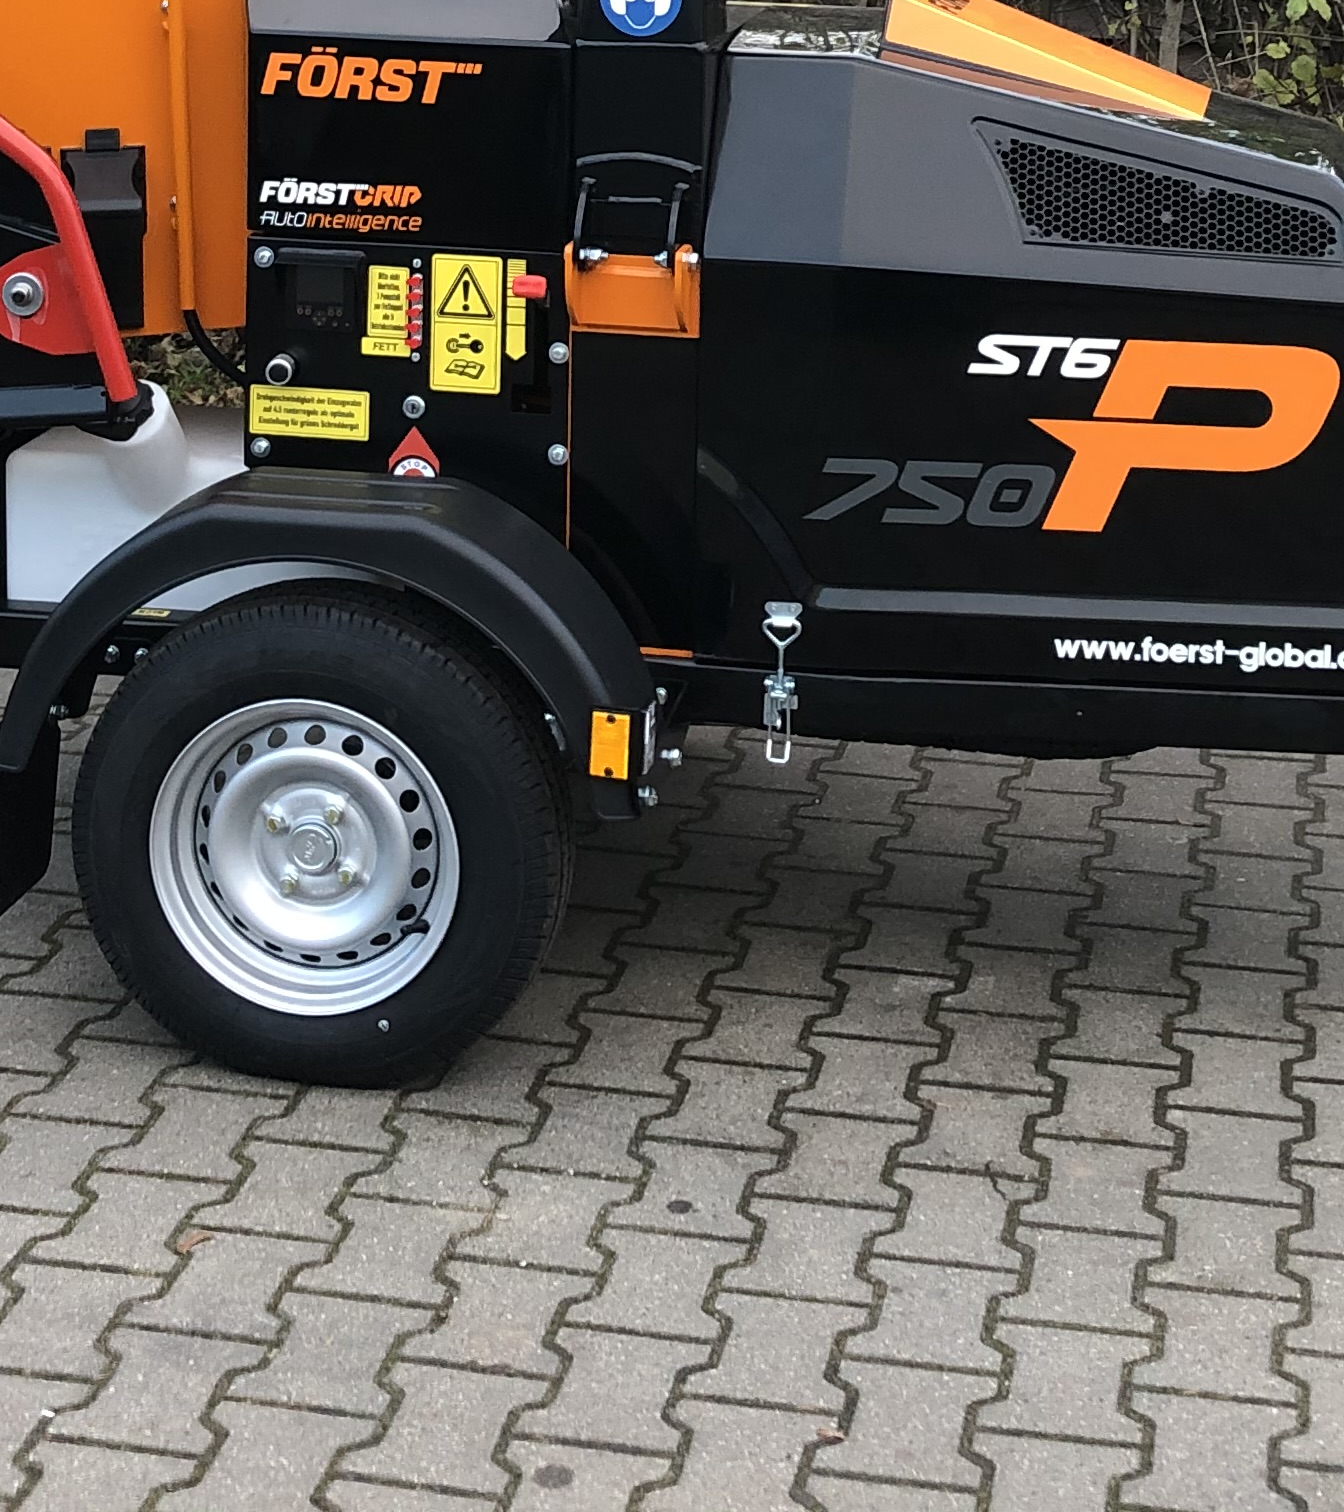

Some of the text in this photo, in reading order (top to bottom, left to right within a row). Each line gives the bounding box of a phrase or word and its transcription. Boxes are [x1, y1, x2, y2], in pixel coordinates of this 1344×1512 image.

[260, 46, 482, 104] FÖRST
[372, 342, 399, 352] FETT
[967, 333, 1121, 380] ST6
[400, 460, 428, 470] STOP
[801, 457, 1056, 528] 750
